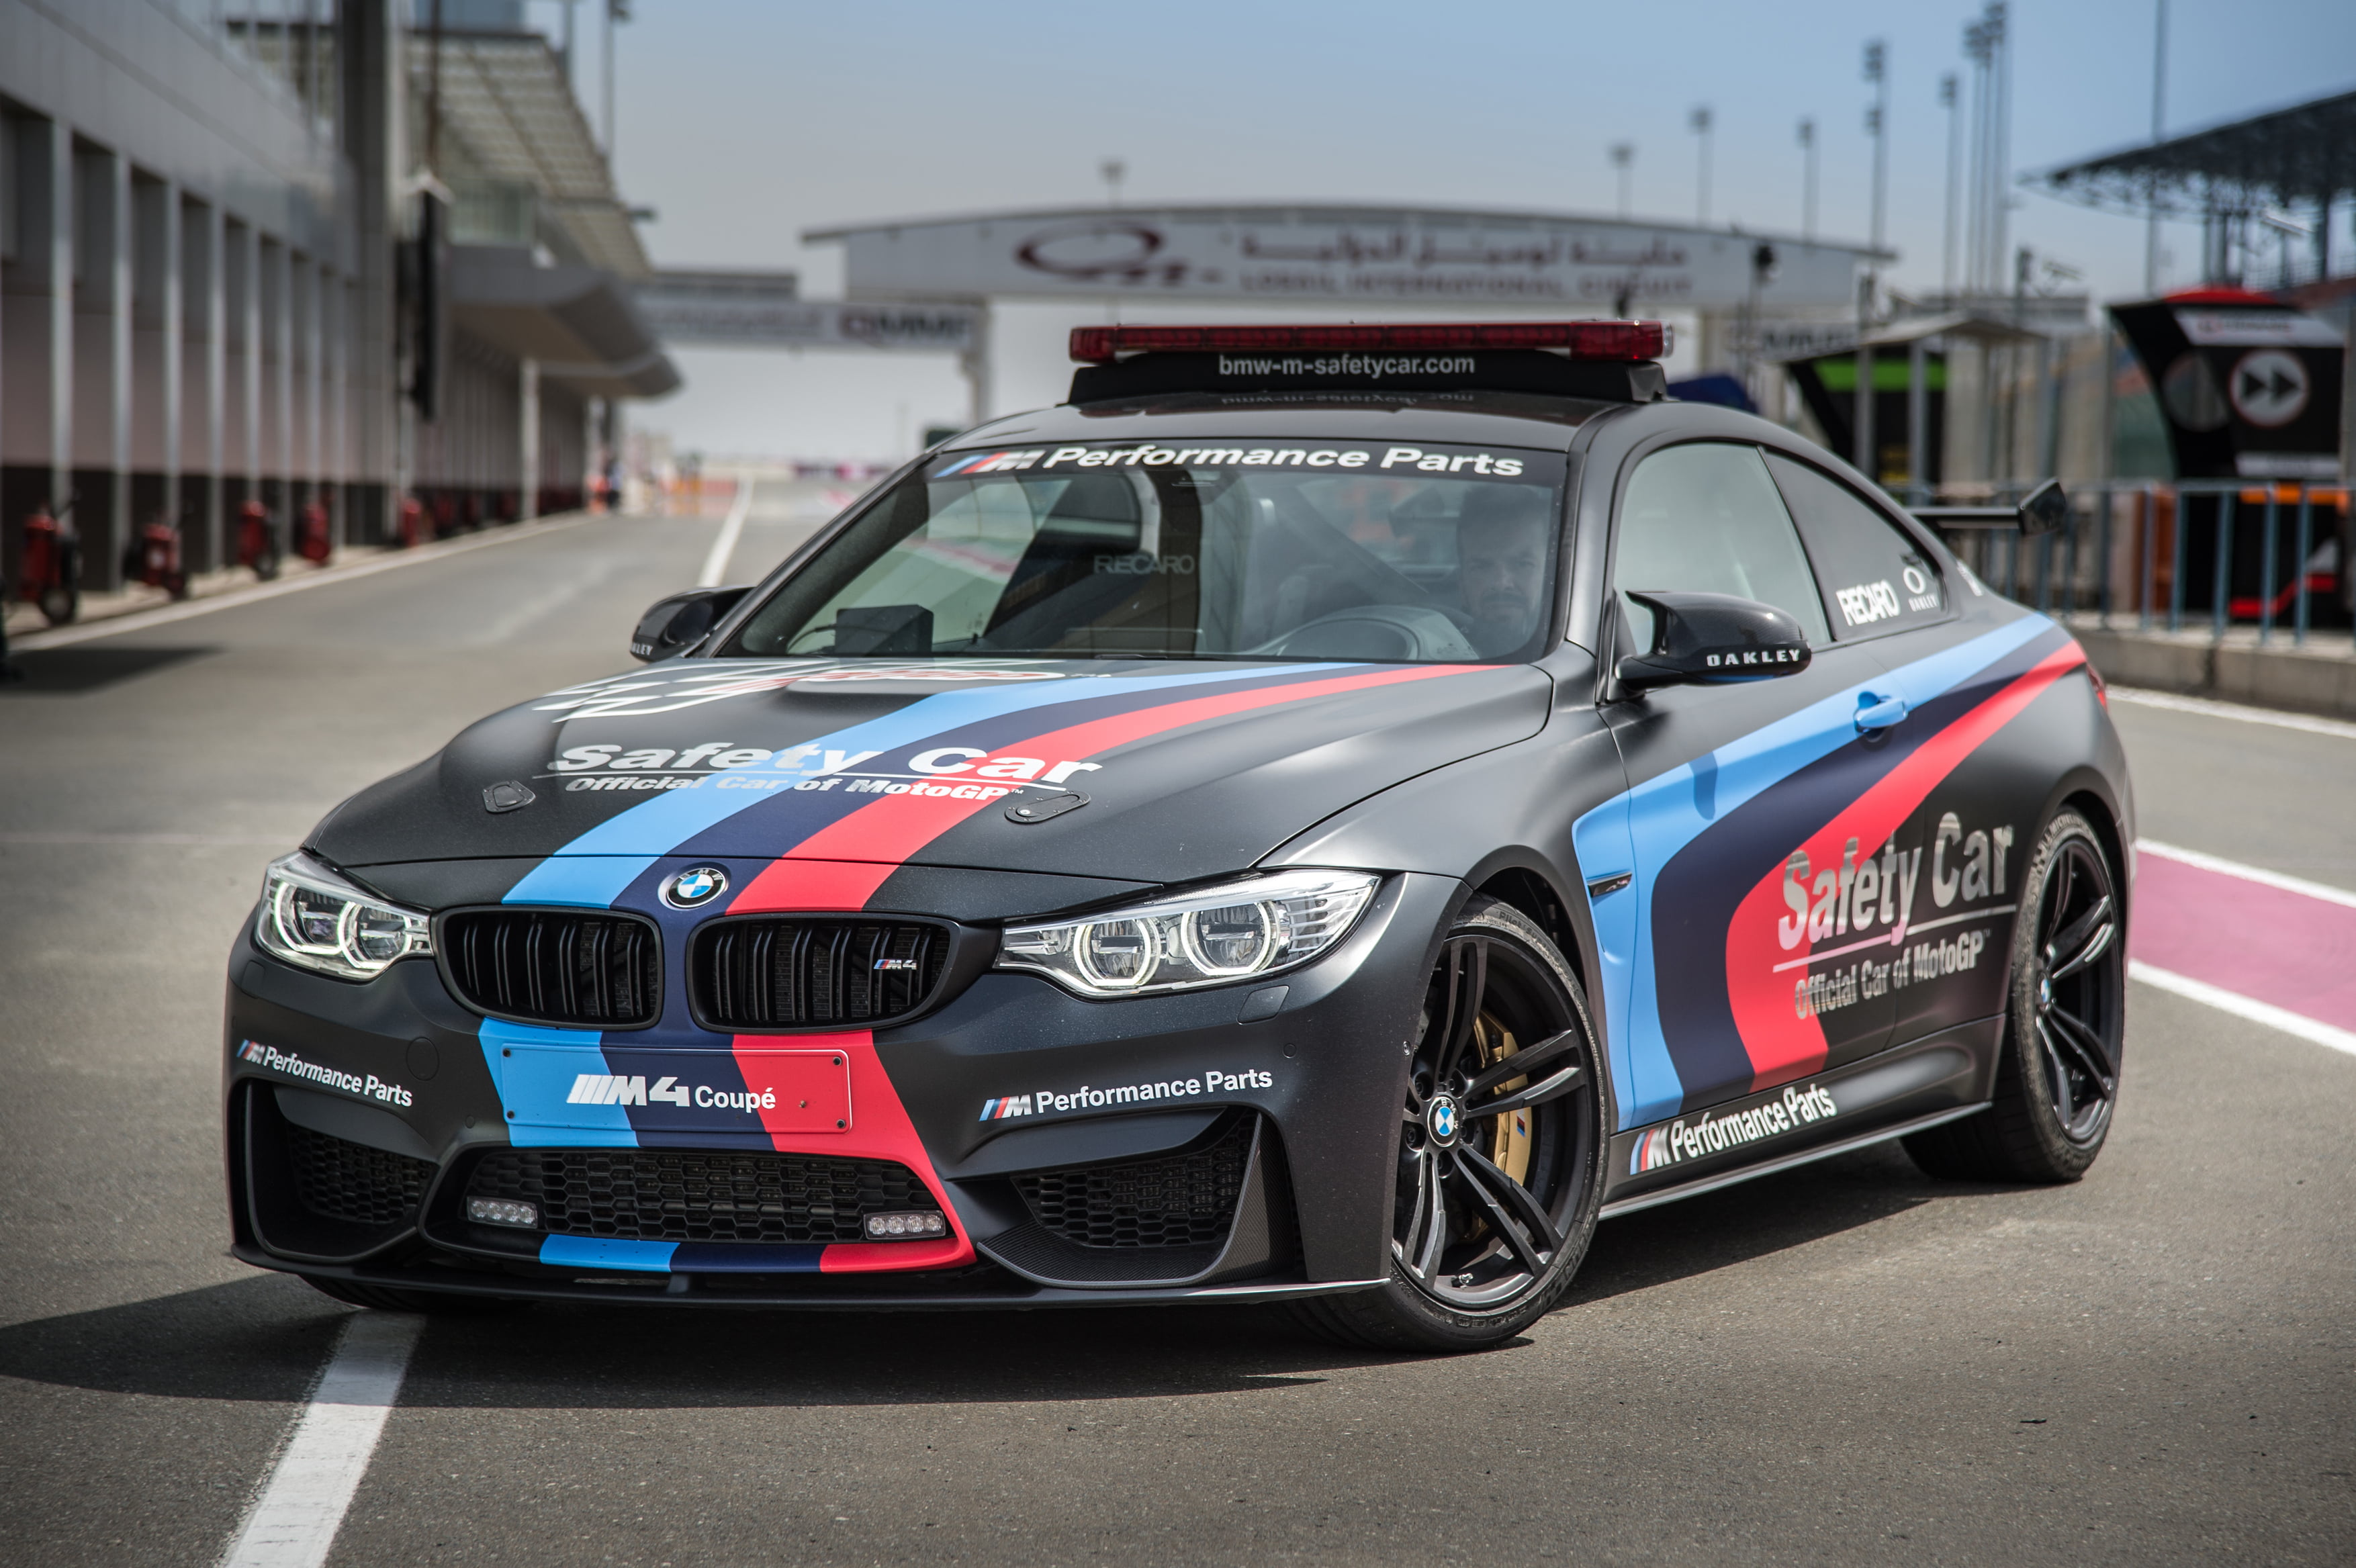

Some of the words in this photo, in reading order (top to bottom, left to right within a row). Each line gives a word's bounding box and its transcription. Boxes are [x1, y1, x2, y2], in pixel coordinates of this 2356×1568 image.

[1218, 354, 1476, 379] bmw-m-safetycar.com
[1042, 445, 1371, 468] Performance
[1379, 447, 1523, 476] Parts
[1093, 554, 1195, 575] RECARO
[1836, 578, 1900, 627] RECARO
[1908, 593, 1940, 612] OAKLEY
[1706, 649, 1801, 667] OAKLEY
[547, 742, 885, 777] Safety
[908, 747, 1103, 784] Car
[565, 776, 705, 792] Official
[716, 776, 789, 790] Car
[793, 778, 843, 791] of
[678, 868, 724, 882] BMW
[1778, 831, 1923, 951] Safety
[1932, 811, 2014, 908] Car
[1795, 962, 1859, 1020] Official
[1860, 959, 1889, 1000] Car
[1893, 946, 1911, 989] of
[263, 1045, 363, 1093] Performance
[363, 1074, 413, 1107] Parts
[1035, 1076, 1201, 1113] Performance
[1206, 1068, 1273, 1093] Parts
[694, 1085, 776, 1113] Coupé
[1670, 1101, 1791, 1162] Performance
[1782, 1082, 1838, 1126] Parts
